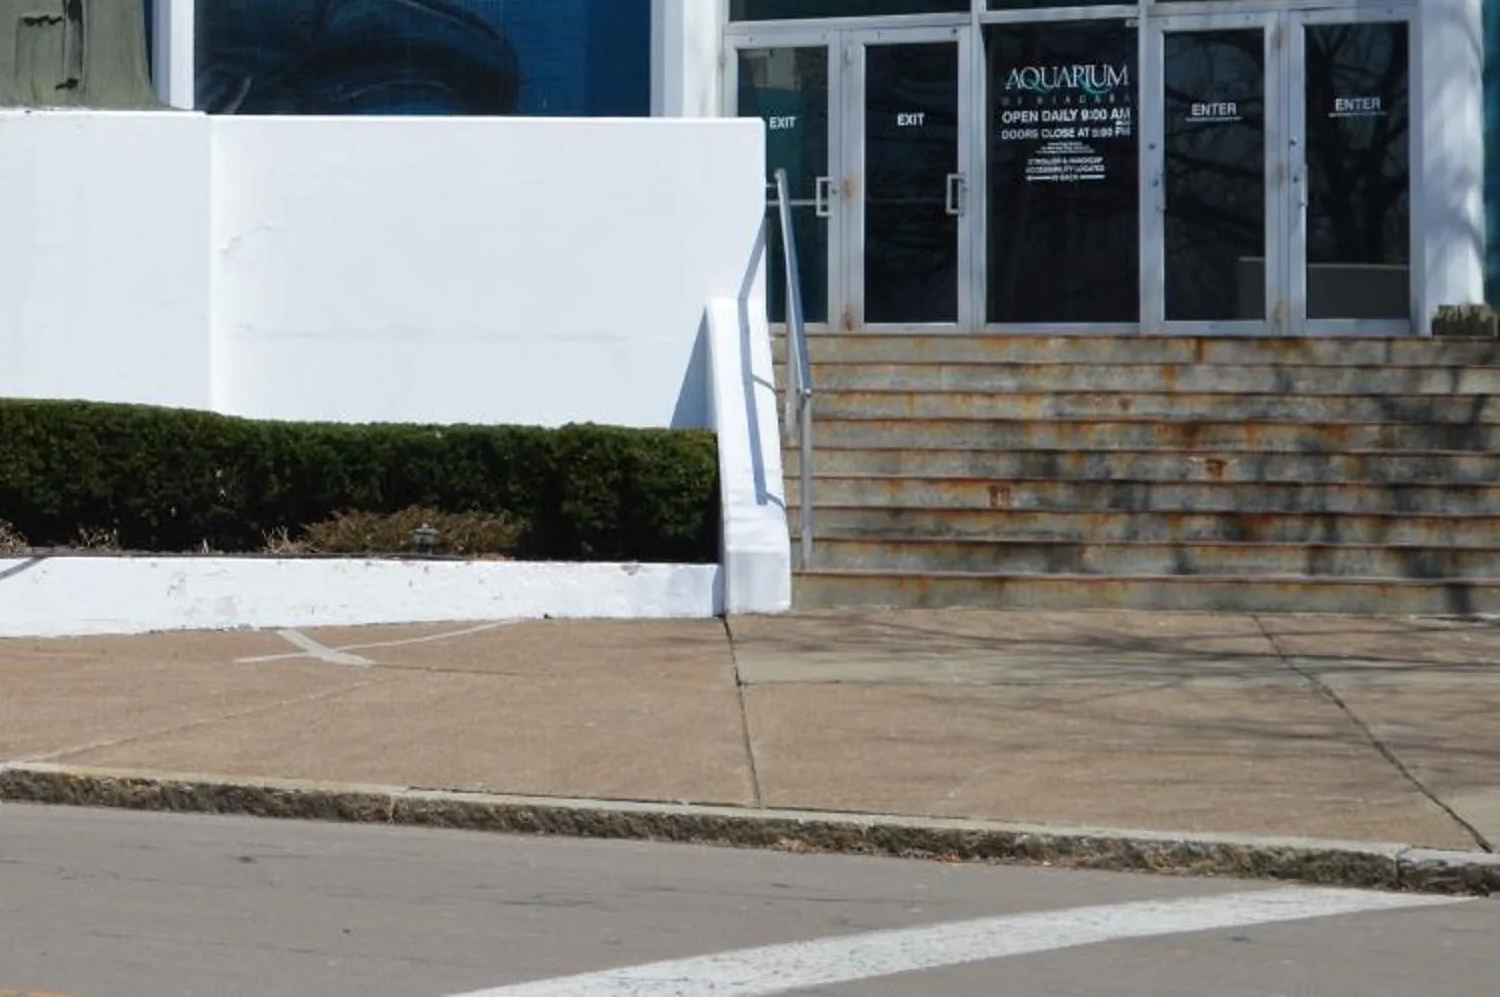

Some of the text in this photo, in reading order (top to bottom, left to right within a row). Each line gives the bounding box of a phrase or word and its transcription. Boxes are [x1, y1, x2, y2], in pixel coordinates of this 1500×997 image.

[1004, 63, 1129, 93] AQUARIUM
[1191, 102, 1237, 116] ENTER
[1335, 97, 1381, 112] ENTER
[896, 113, 924, 126] EXIT
[1001, 109, 1038, 123] OPEN
[1041, 108, 1078, 122] DAILY
[1110, 107, 1131, 120] AM
[769, 116, 796, 129] EXIT
[1001, 128, 1038, 139] DOORS
[1041, 127, 1075, 138] CLOSE
[1077, 126, 1089, 138] AT
